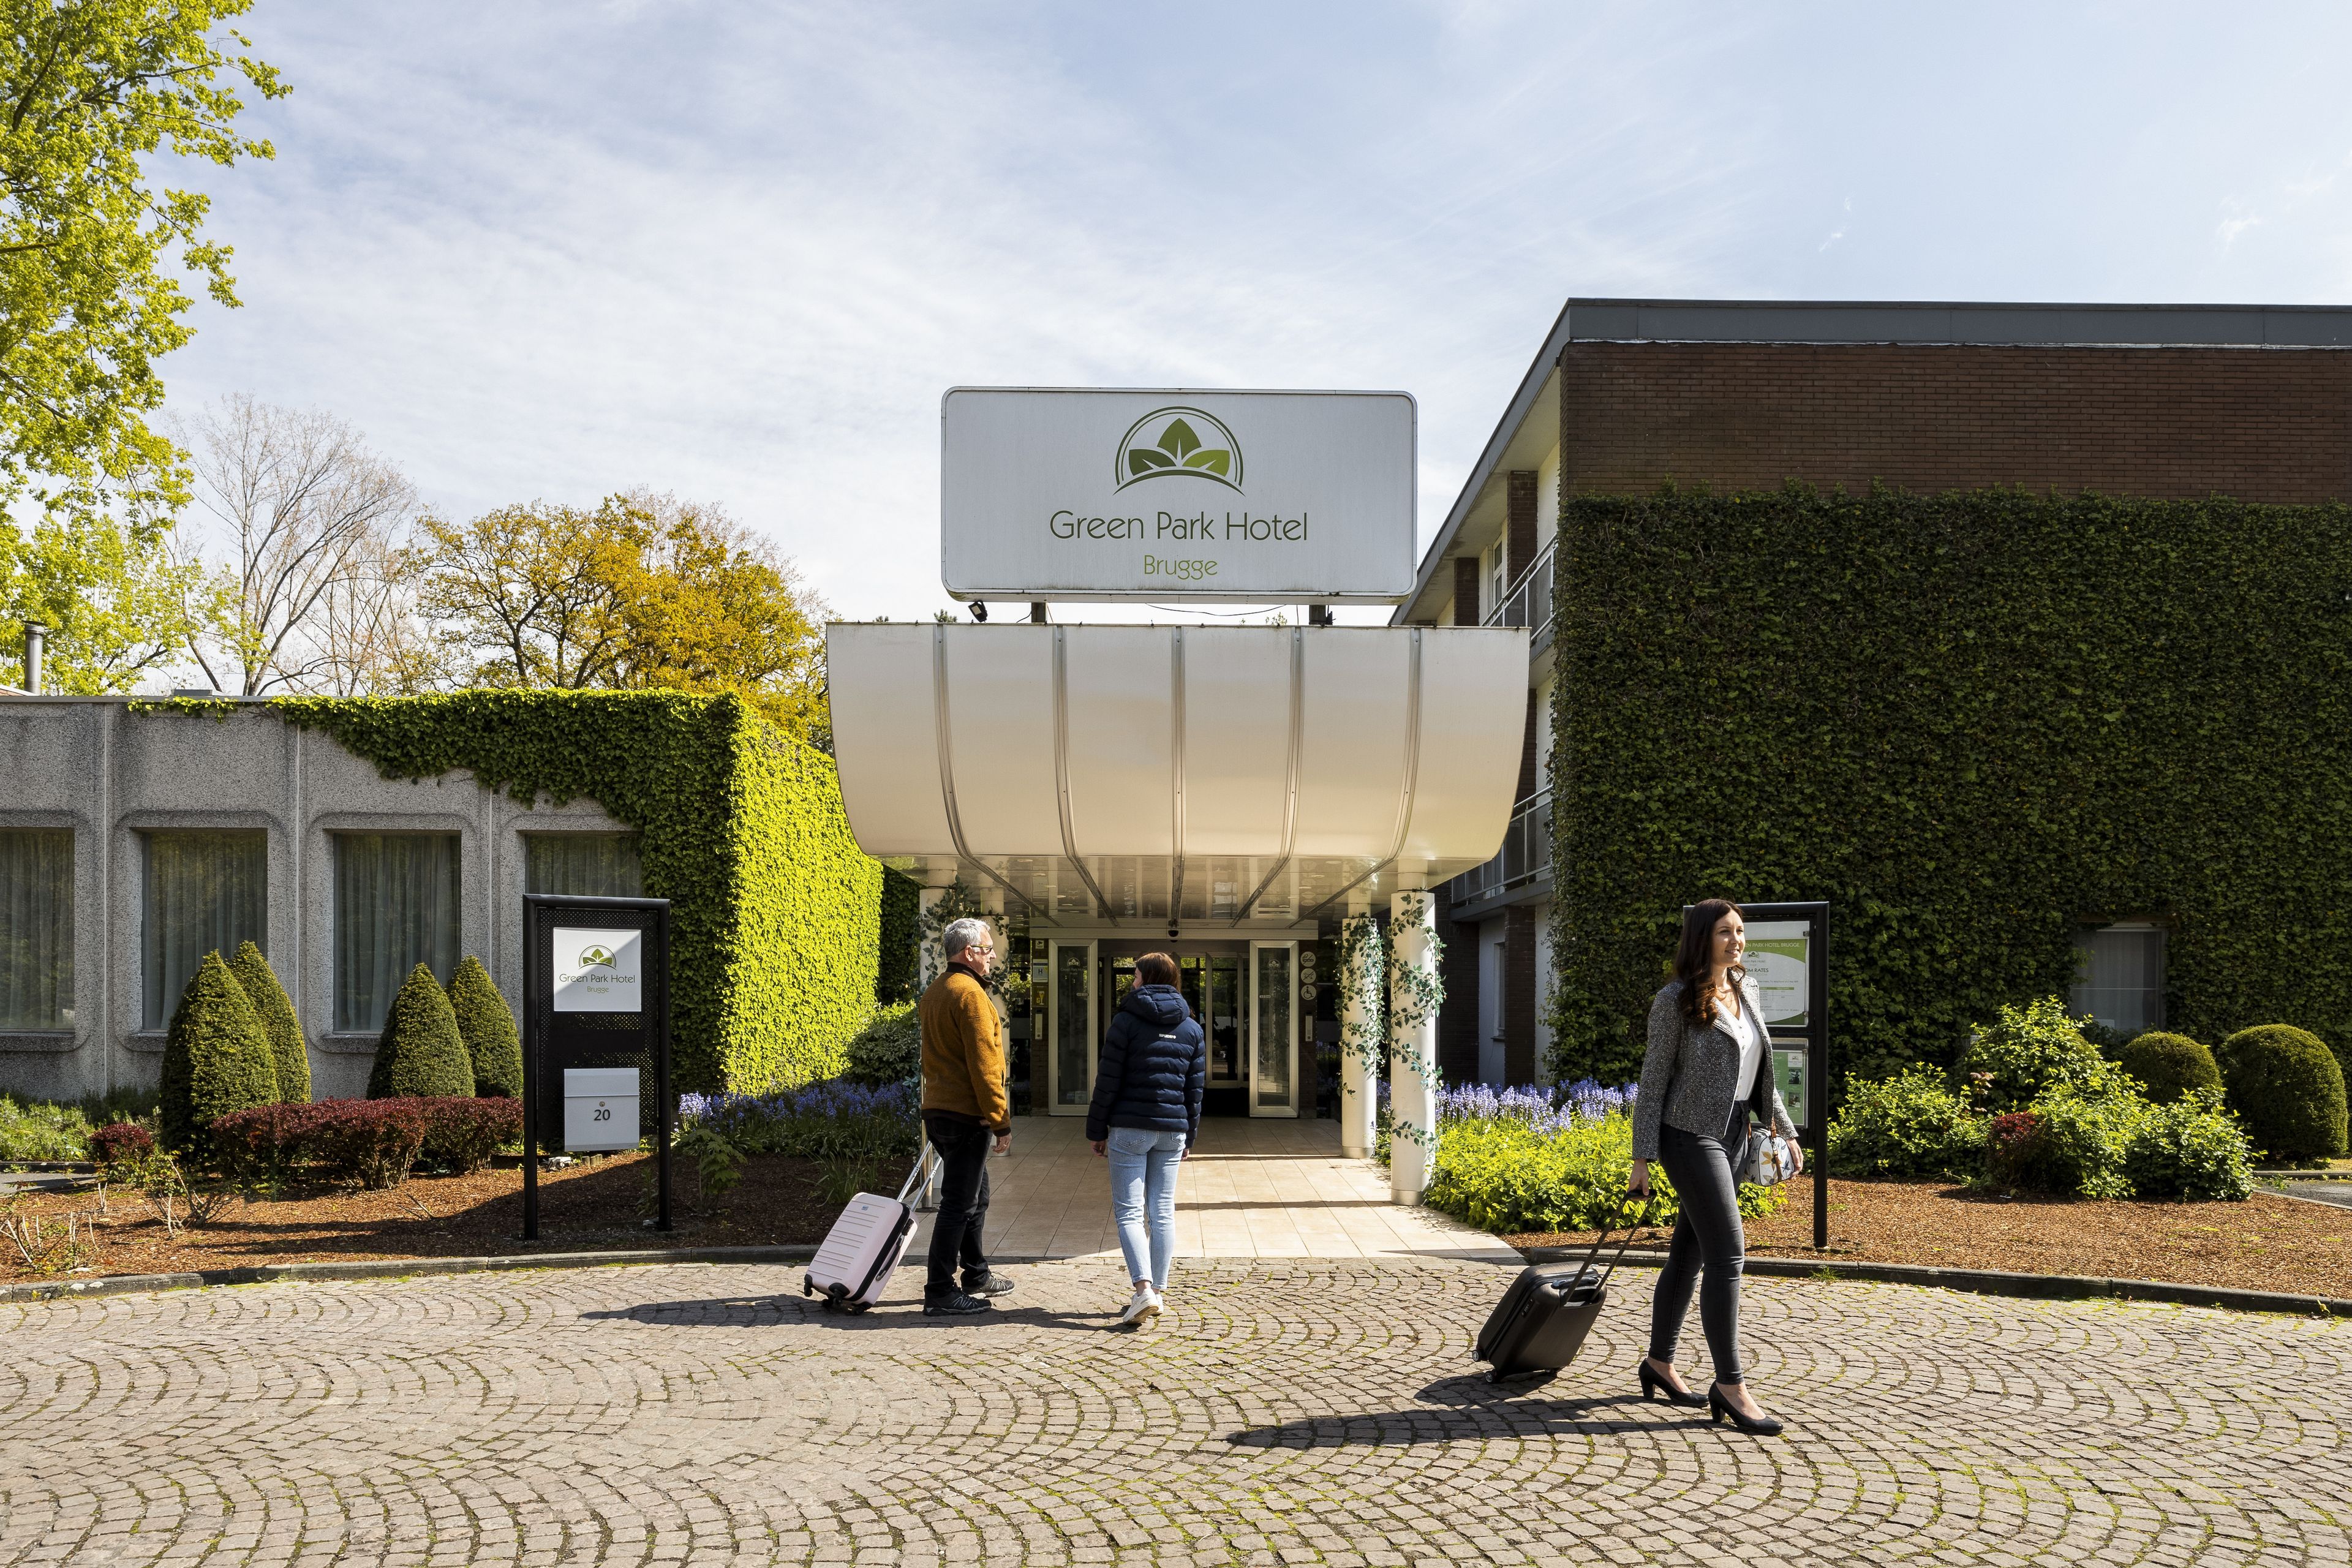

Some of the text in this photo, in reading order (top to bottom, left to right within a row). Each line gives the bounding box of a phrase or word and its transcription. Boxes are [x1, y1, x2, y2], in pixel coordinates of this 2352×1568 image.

[1050, 510, 1307, 541] Green Park Hotel
[1144, 555, 1218, 580] Brugge
[559, 973, 635, 983] Green Park Hotel
[594, 1109, 611, 1121] 20
